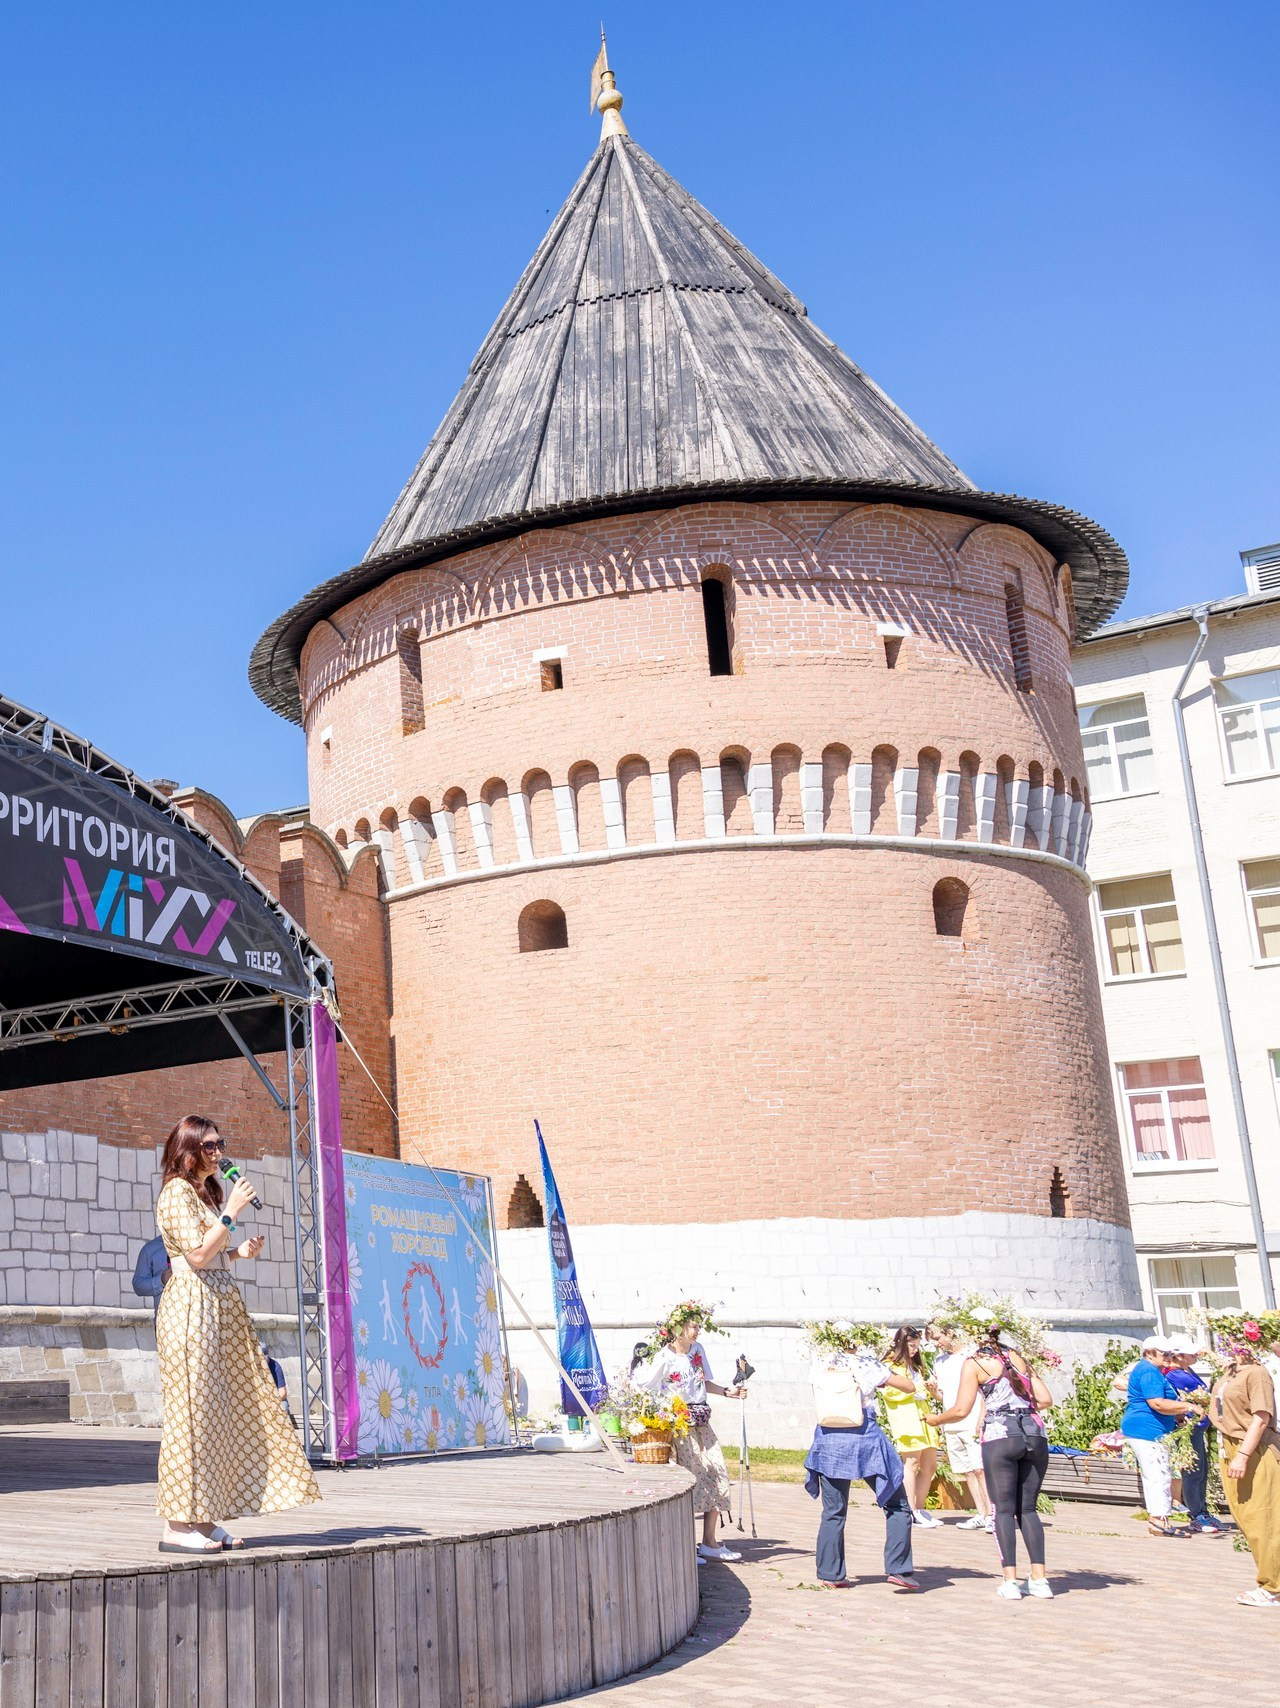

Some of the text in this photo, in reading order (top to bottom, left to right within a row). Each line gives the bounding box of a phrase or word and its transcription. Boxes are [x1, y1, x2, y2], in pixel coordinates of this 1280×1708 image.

[244, 950, 282, 976] TELE2
[370, 1203, 458, 1236] РОМАШКОВЫЙ
[391, 1231, 448, 1262] ХОРОВОД
